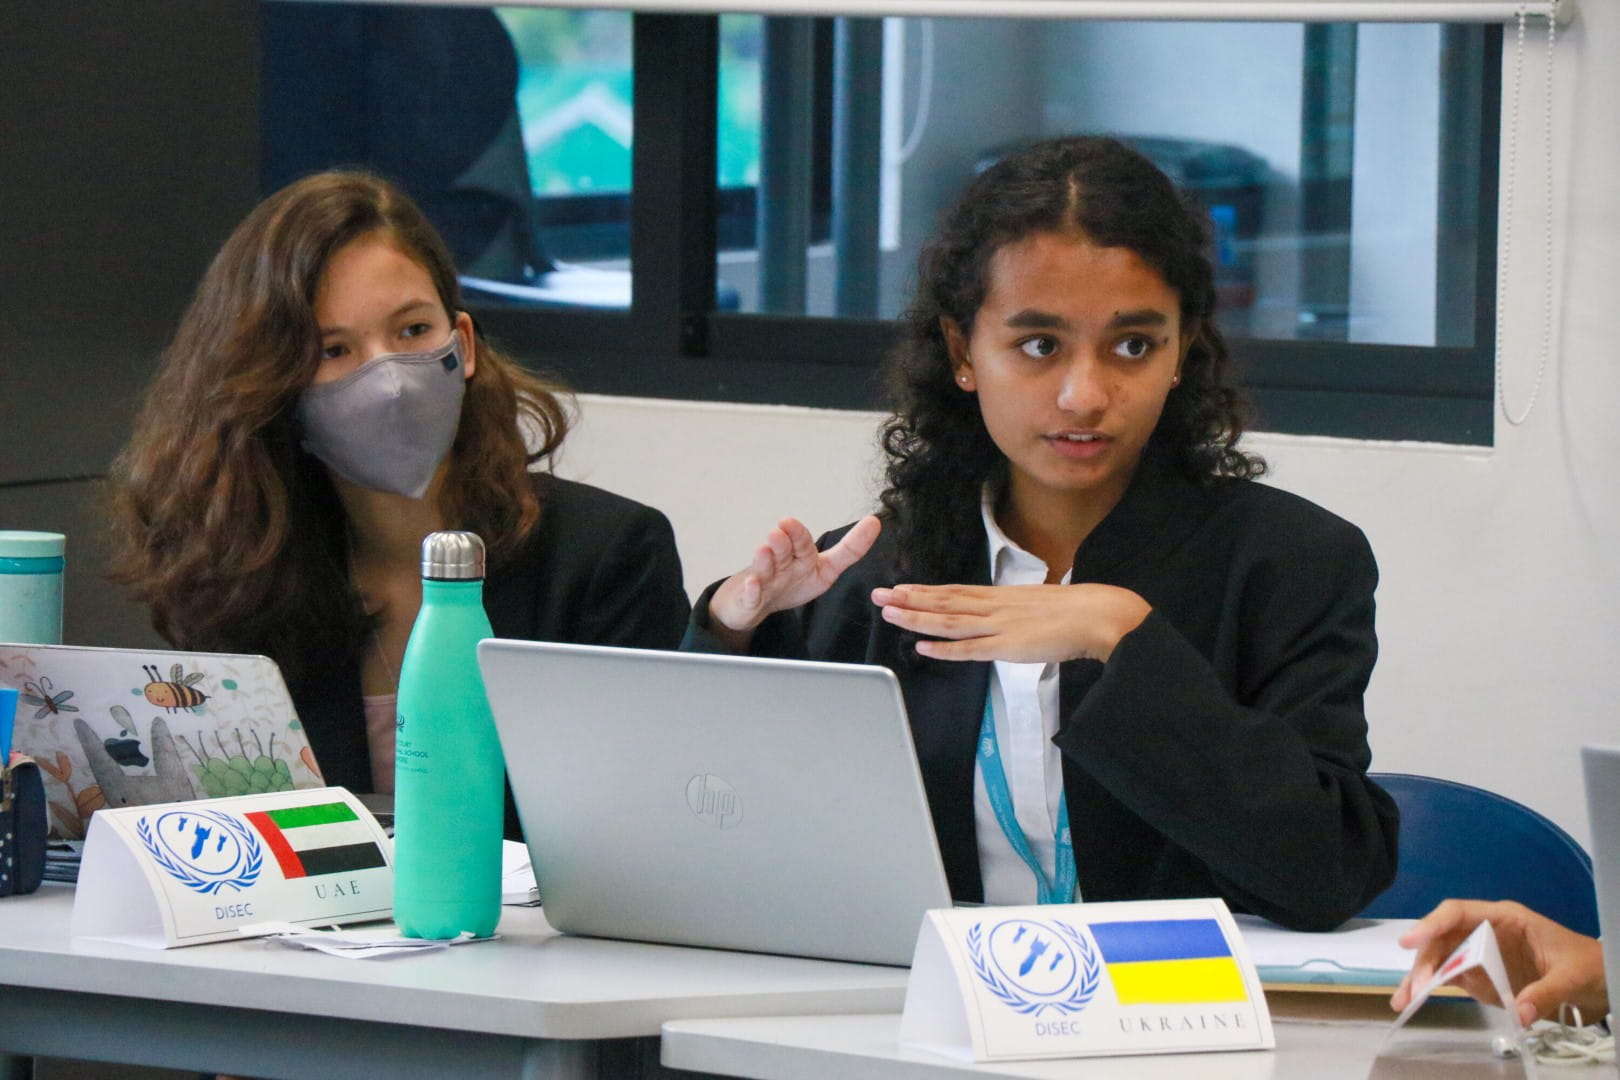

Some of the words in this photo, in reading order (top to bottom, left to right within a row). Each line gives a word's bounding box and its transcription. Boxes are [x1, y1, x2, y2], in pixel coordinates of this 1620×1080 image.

[694, 773, 737, 830] hp
[315, 880, 361, 900] UAE
[215, 903, 254, 920] DISEC
[1035, 1021, 1081, 1037] DISEC
[1119, 1013, 1246, 1033] UKRAINE
